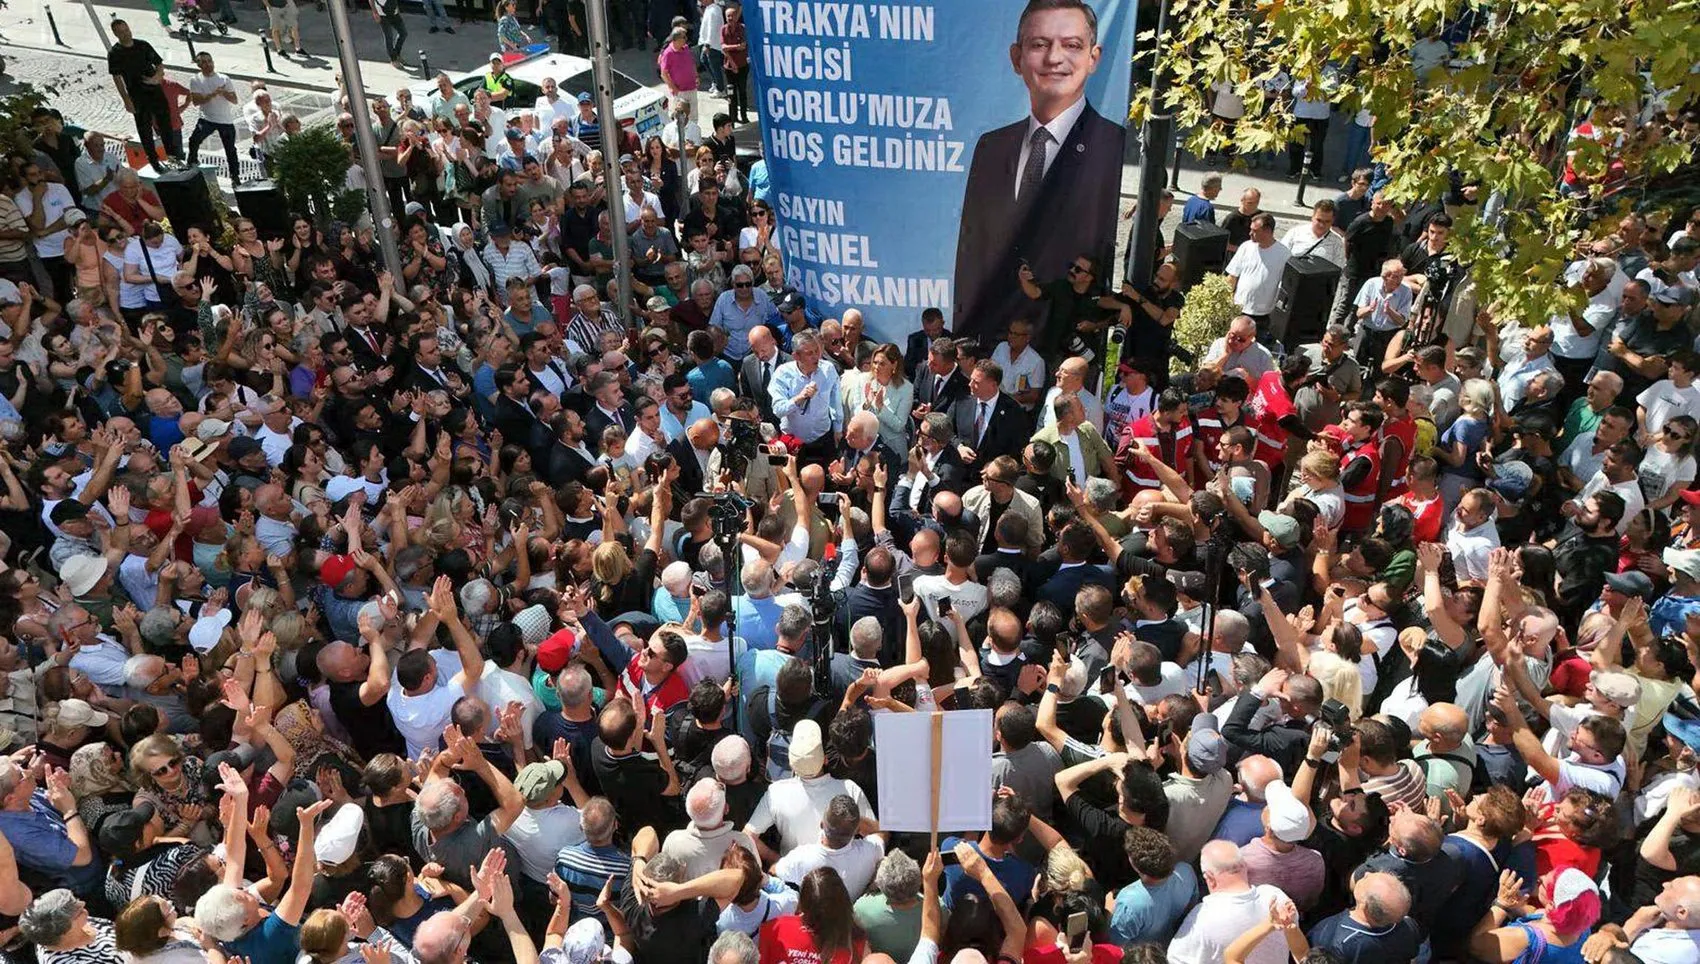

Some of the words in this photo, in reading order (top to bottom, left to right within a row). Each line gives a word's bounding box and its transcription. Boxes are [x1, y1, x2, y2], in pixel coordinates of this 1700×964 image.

[758, 0, 935, 41] TRAKYA'NIN
[763, 37, 852, 82] İNCİSİ
[767, 87, 953, 131] ÇORLU'MUZA
[770, 127, 825, 167] HOŞ
[833, 132, 965, 172] GELDİNİZ
[778, 192, 845, 226] SAYIN
[783, 225, 878, 268] GENEL
[788, 264, 950, 308] BAŞKANIM
